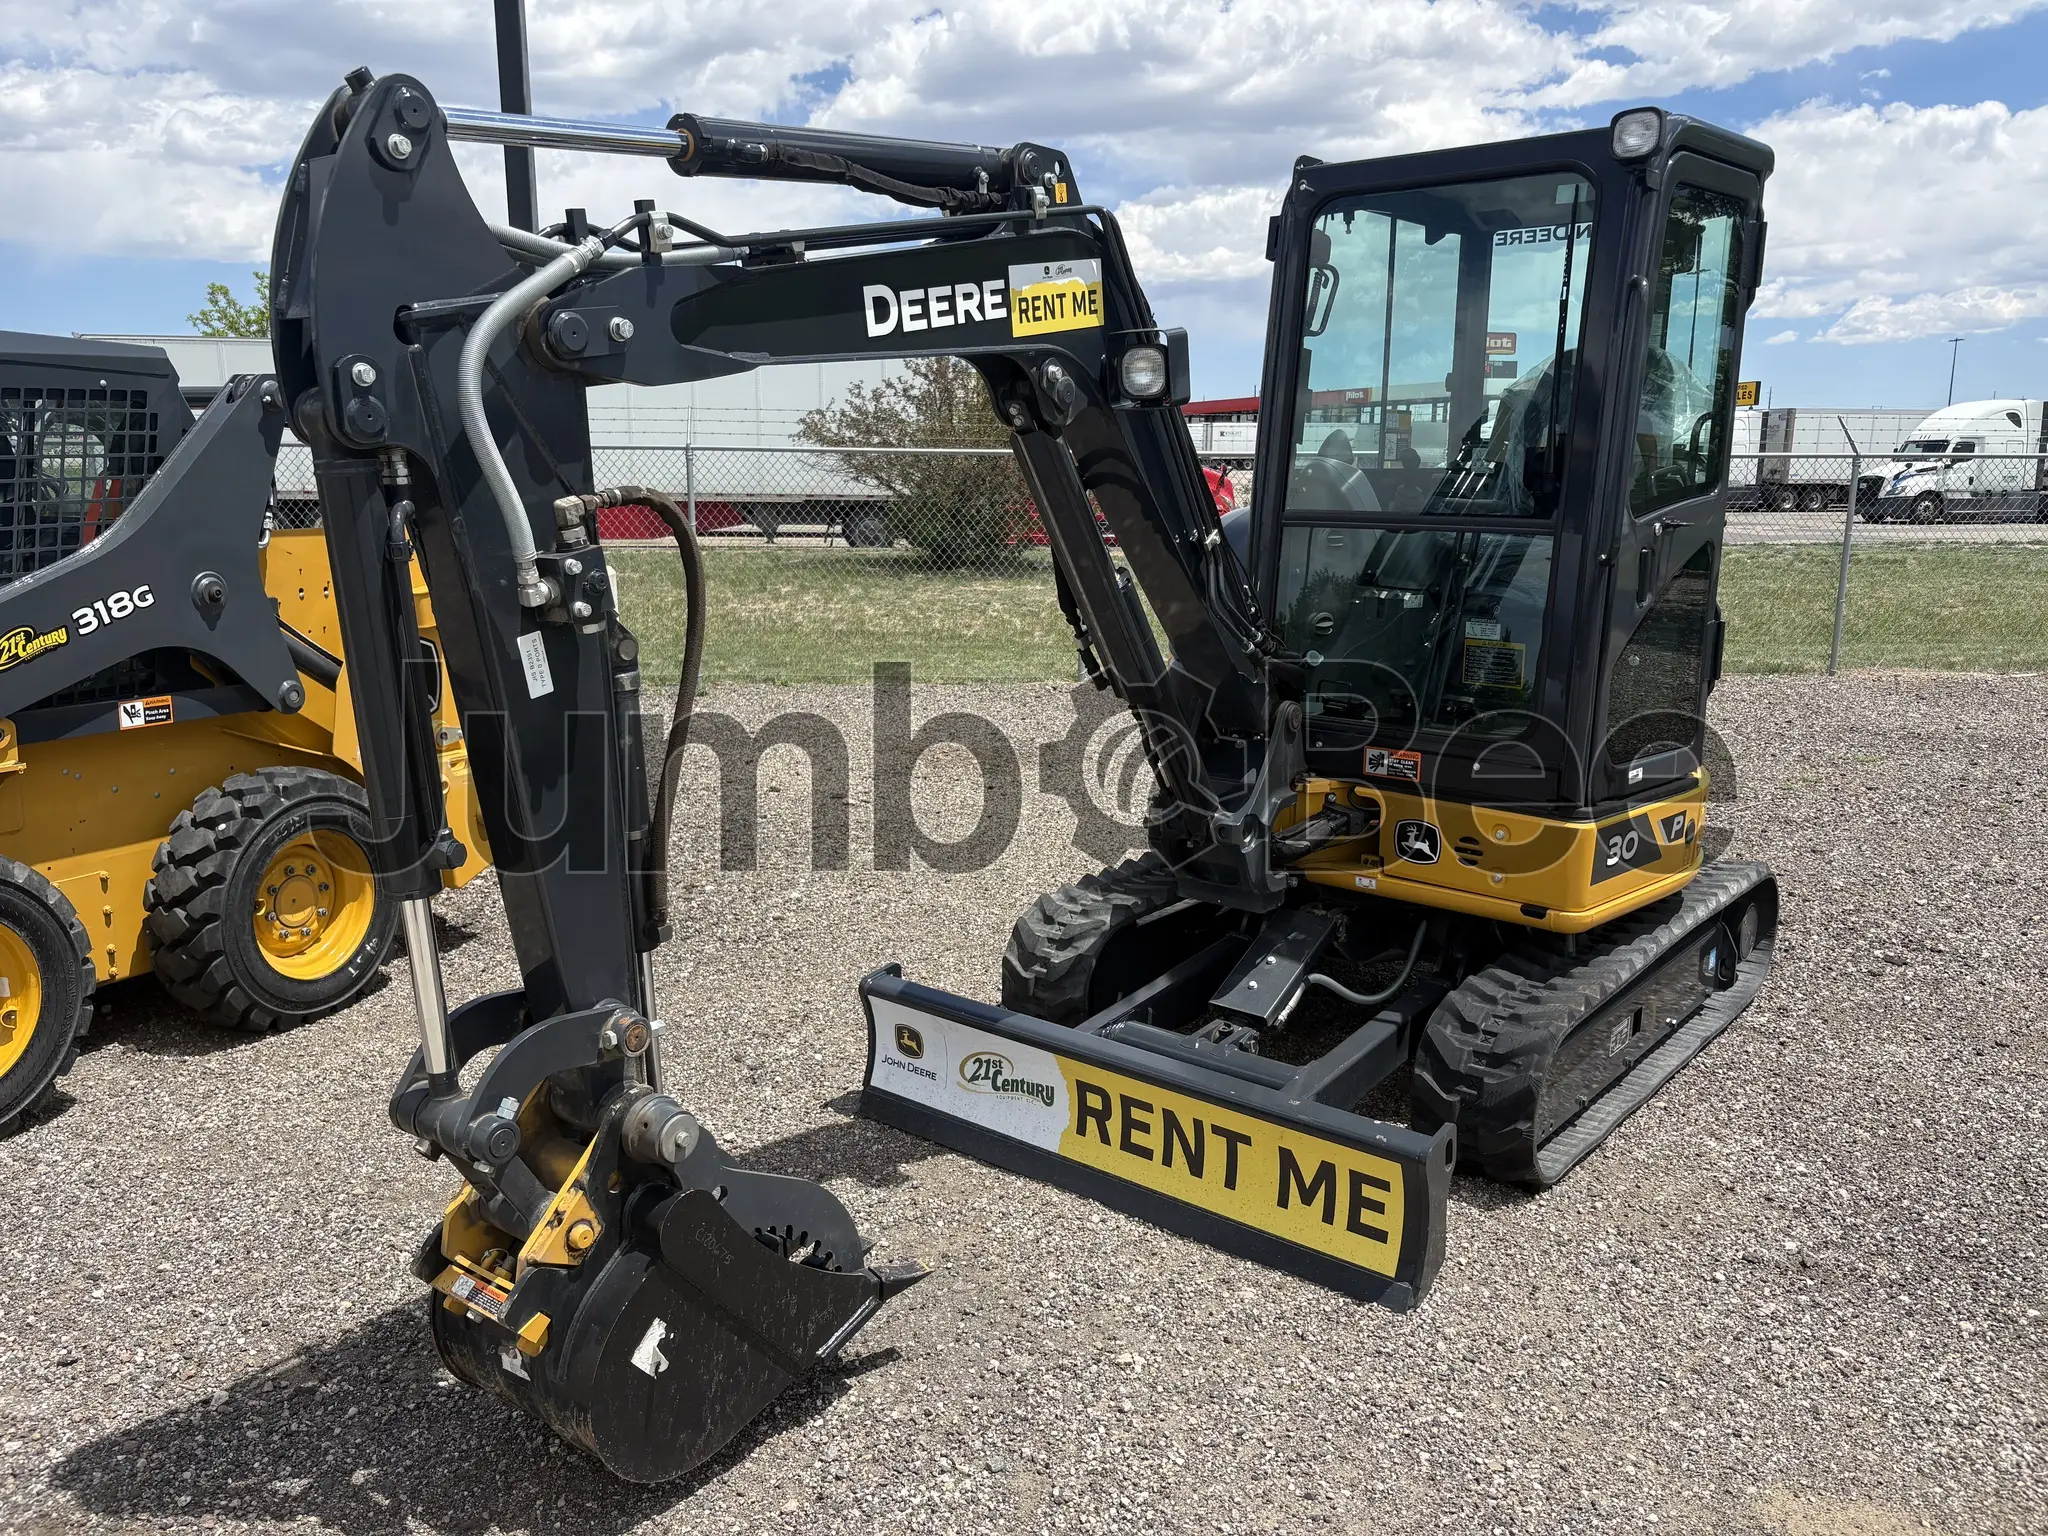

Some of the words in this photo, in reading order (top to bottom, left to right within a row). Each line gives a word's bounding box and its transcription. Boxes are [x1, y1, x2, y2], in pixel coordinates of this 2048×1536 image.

[863, 279, 1007, 337] DEERE
[1018, 292, 1067, 324] RENT
[1072, 289, 1098, 317] ME
[71, 584, 155, 635] 318G
[531, 638, 541, 663] PORTS
[539, 669, 547, 688] TYPE
[1394, 751, 1418, 759] WARNING
[1606, 830, 1639, 866] 30
[1670, 815, 1684, 840] P
[881, 1054, 906, 1070] JOHN
[906, 1062, 938, 1081] DEERE
[968, 1057, 1004, 1084] 21st
[991, 1069, 1055, 1107] Century
[1075, 1078, 1253, 1191] RENT
[1276, 1145, 1392, 1245] ME
